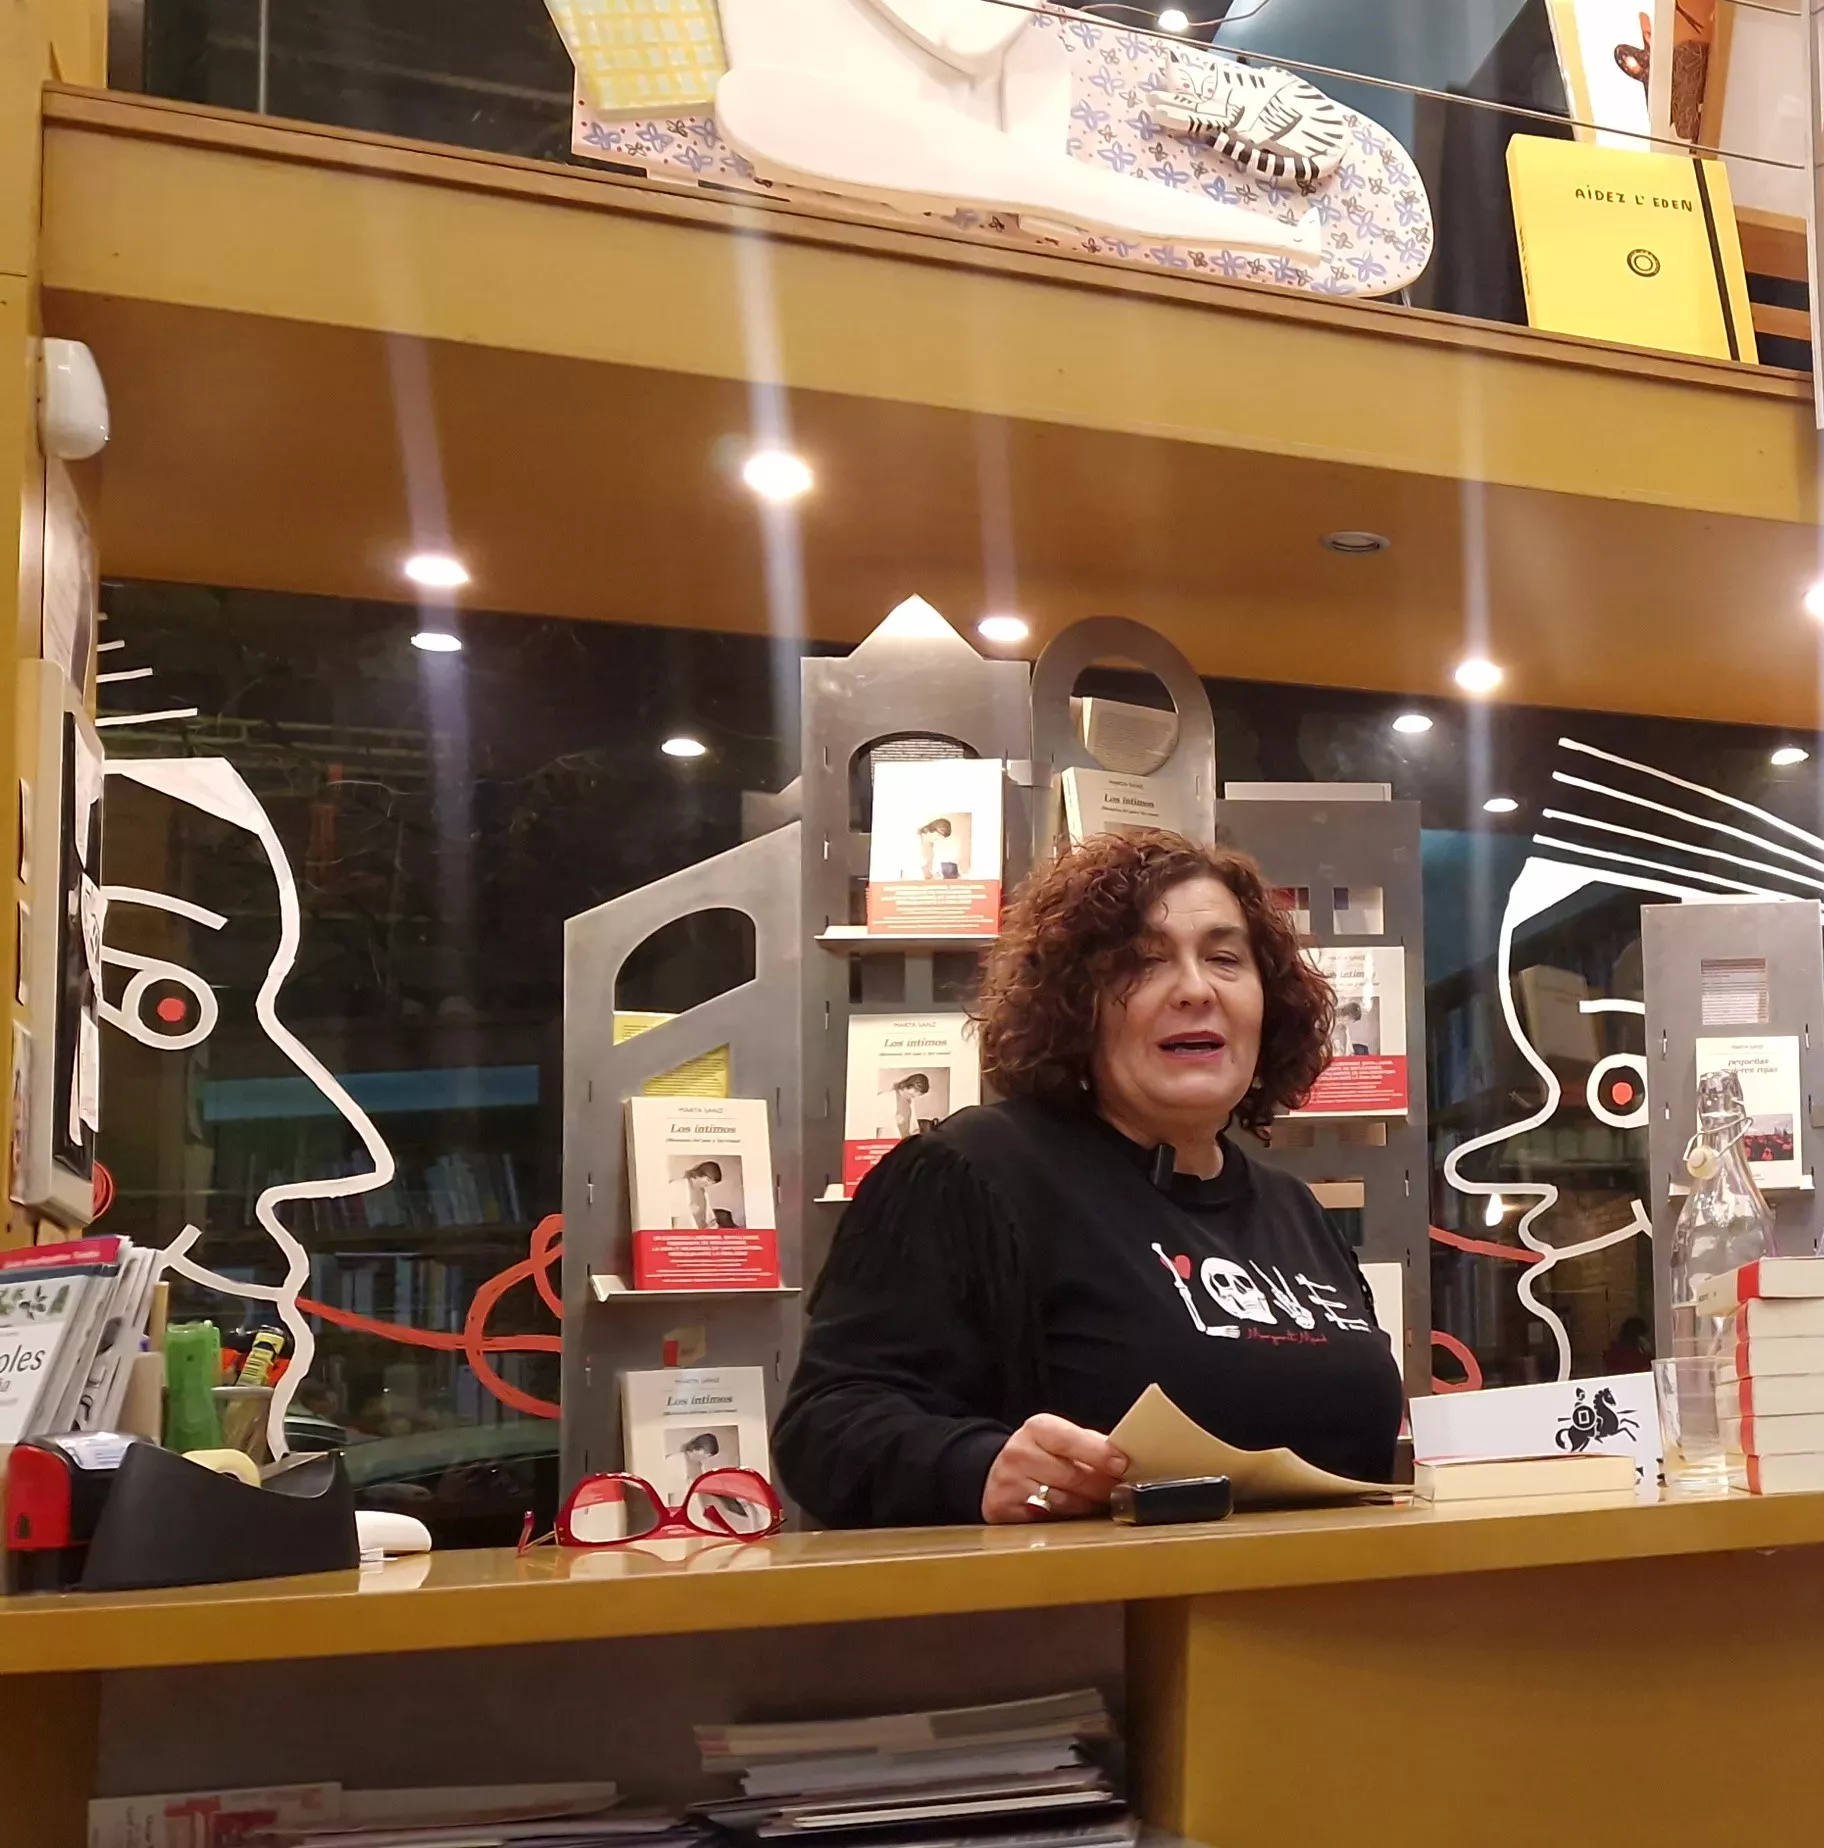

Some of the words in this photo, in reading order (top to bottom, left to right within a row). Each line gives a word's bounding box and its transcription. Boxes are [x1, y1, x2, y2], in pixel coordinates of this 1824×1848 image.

[1653, 197, 1693, 212] EDEN
[884, 1038, 903, 1048] Los
[906, 1038, 948, 1048] íntimos
[670, 1123, 691, 1134] Los
[694, 1123, 737, 1134] íntimos
[666, 1396, 688, 1406] Los
[691, 1394, 733, 1405] íntimos
